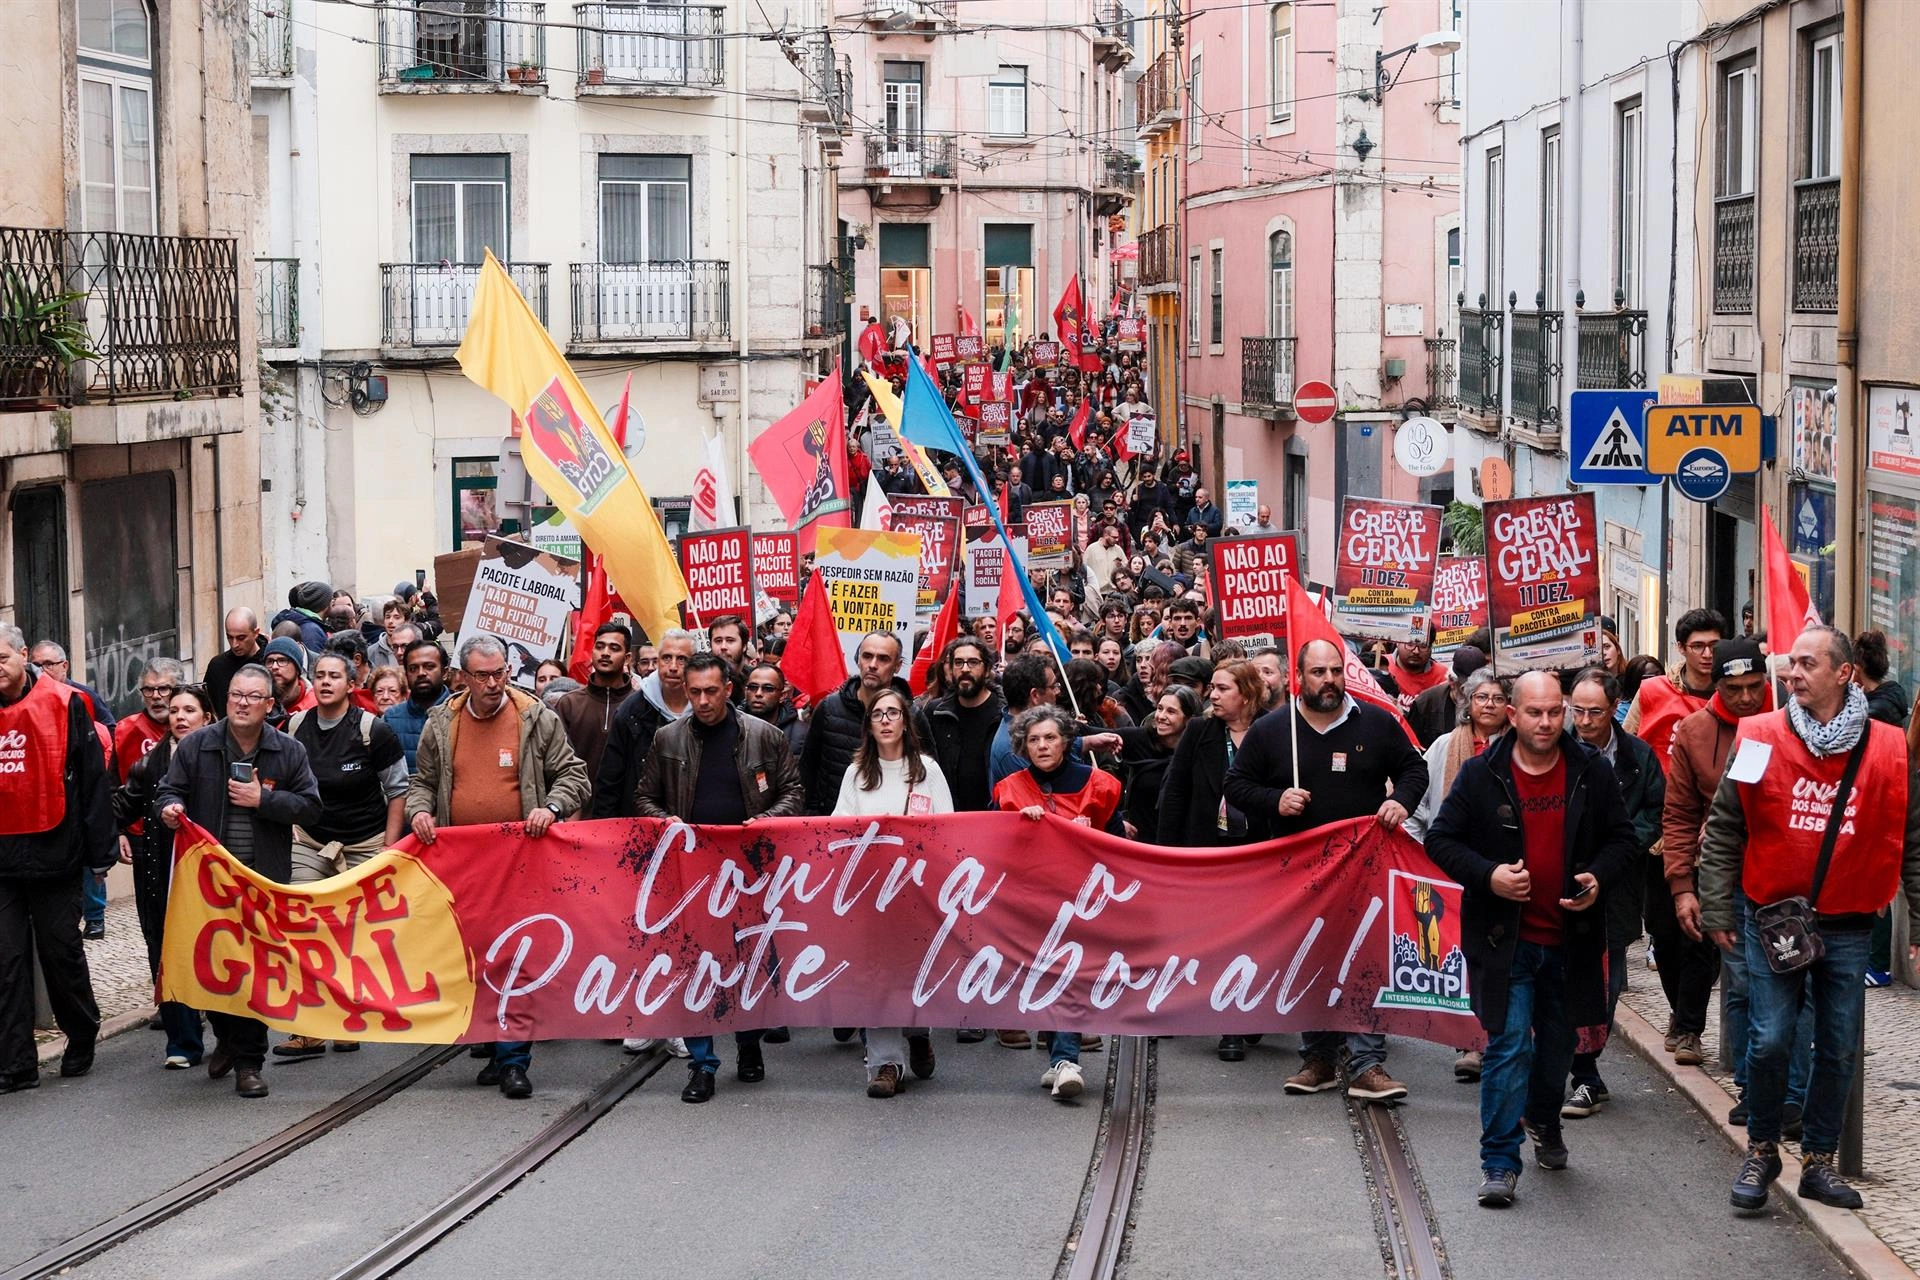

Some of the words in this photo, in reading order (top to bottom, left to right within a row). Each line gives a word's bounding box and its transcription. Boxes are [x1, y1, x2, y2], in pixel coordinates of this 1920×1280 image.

[1666, 414, 1742, 436] ATM
[1026, 507, 1064, 524] GREVE
[1350, 508, 1426, 542] GREVE
[1494, 500, 1581, 547] GREVE
[1027, 519, 1068, 536] GERAL
[564, 544, 581, 554] CRIA
[689, 540, 718, 564] NÃO
[721, 539, 740, 560] AO
[754, 538, 775, 554] NÃO
[777, 538, 790, 554] AO
[1347, 534, 1430, 570] GERAL
[754, 555, 792, 572] PACOTE
[1223, 544, 1260, 570] NÃO
[1264, 544, 1288, 566] AO
[1497, 531, 1591, 583] GERAL
[481, 566, 521, 588] PACOTE
[522, 578, 566, 602] LABORAL
[690, 562, 742, 588] PACOTE
[756, 572, 796, 588] ABORAL
[820, 565, 862, 579] DESPEDIR
[864, 568, 882, 582] SEM
[884, 568, 914, 583] RAZÃO
[918, 576, 930, 590] EZ.
[976, 577, 998, 585] SOCIAL
[1361, 568, 1373, 584] 11
[1376, 570, 1408, 588] DEZ.
[1434, 560, 1480, 588] GREVE
[686, 587, 749, 613] LABORAL
[842, 585, 878, 600] FAZER
[1356, 596, 1380, 604] PACOTE
[1382, 596, 1411, 605] LABORAL
[1368, 589, 1394, 597] CONTRA
[1431, 580, 1484, 612] GERAL
[1519, 586, 1534, 606] 11
[1537, 582, 1574, 606] DEZ.
[508, 596, 535, 612] RIMA
[844, 601, 894, 618] VONTADE
[1222, 594, 1287, 620] LABORA
[1530, 607, 1560, 620] CONTRA
[478, 616, 492, 630] DE
[482, 602, 504, 619] COM
[507, 609, 544, 629] FUTURO
[1441, 614, 1450, 627] 11
[1452, 614, 1472, 627] DEZ.
[1514, 625, 1519, 634] O
[1520, 620, 1547, 633] PACOTE
[1548, 612, 1580, 626] LABORAL
[1226, 624, 1246, 634] OUTRO
[1502, 640, 1513, 648] NÃO
[1522, 630, 1553, 644] RETROCESSO
[1562, 620, 1593, 634] EXPLORAÇÃO
[1240, 638, 1268, 648] SALÁRIO
[1792, 799, 1809, 812] DOS
[1810, 802, 1856, 817] SINDIOS
[1788, 814, 1856, 835] LISBA
[636, 822, 1006, 934] Contra
[198, 853, 408, 959] GREVE
[1778, 949, 1800, 960] adidas
[194, 919, 440, 1032] GERAL
[483, 907, 850, 1030] Pacote
[1395, 966, 1460, 998] CGTP
[1384, 993, 1436, 1004] INTERSINDICAL
[1438, 998, 1470, 1008] NACIONAL
